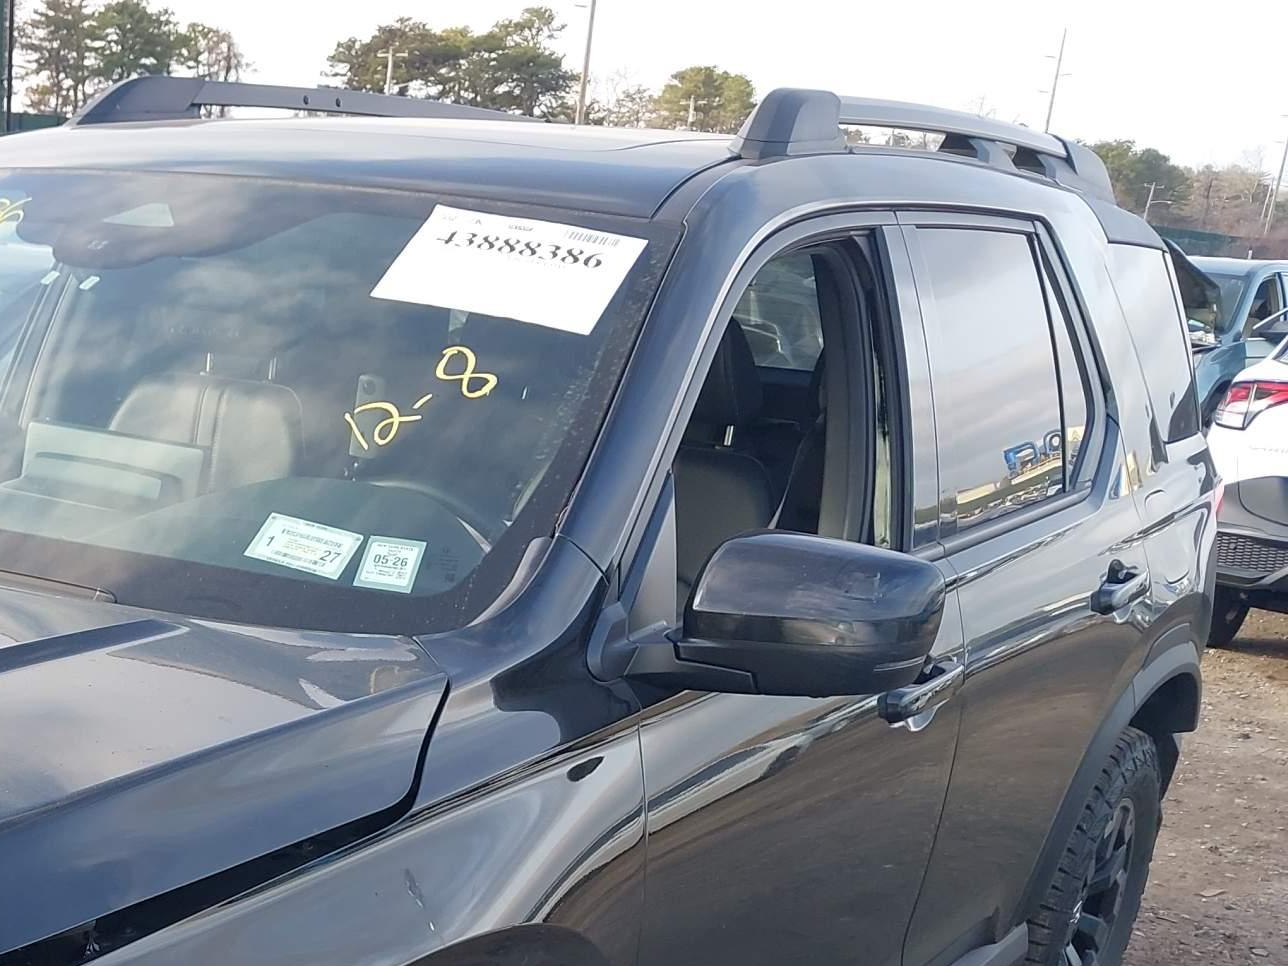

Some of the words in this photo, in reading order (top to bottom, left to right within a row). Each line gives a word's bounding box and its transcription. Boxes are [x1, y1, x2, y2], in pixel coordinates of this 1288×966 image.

[436, 229, 604, 270] 43888386
[318, 549, 342, 565] 27
[372, 553, 409, 568] 05-26
